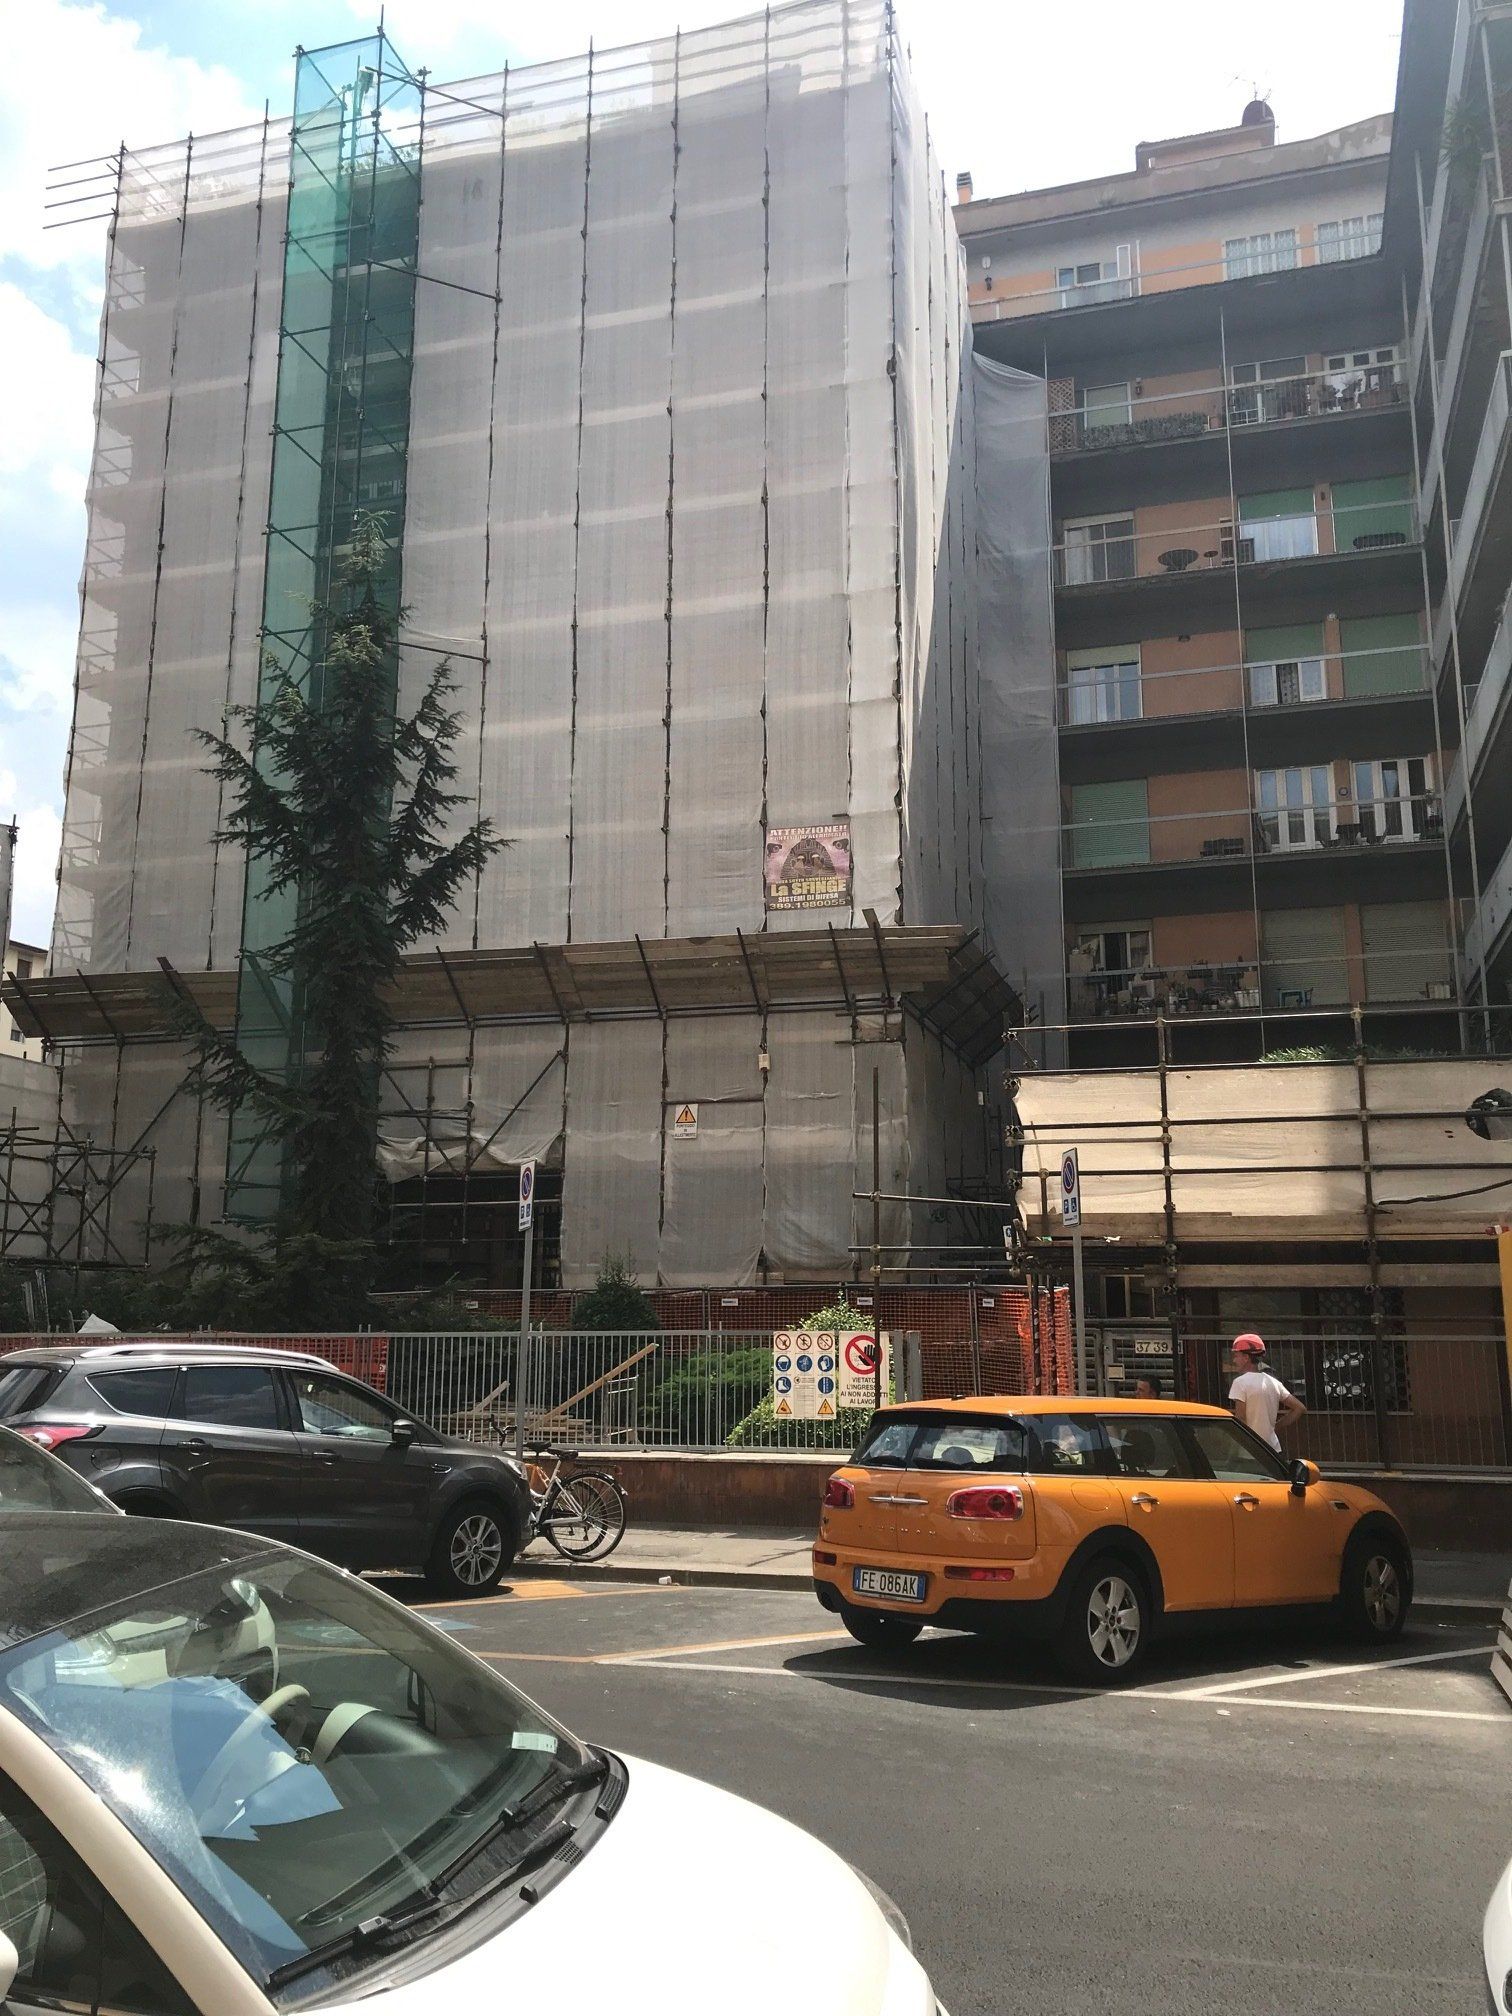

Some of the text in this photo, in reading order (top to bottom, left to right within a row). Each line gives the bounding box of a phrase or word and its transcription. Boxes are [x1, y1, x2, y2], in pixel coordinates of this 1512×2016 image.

[770, 825, 847, 836] ATTENZIONE!!
[791, 879, 847, 895] SFINGE
[778, 894, 806, 903] SISTEMI
[815, 892, 839, 900] DIFESA
[1136, 1341, 1150, 1352] 37
[1153, 1341, 1168, 1352] 39
[861, 1571, 876, 1589] FE
[880, 1574, 917, 1595] 086AK
